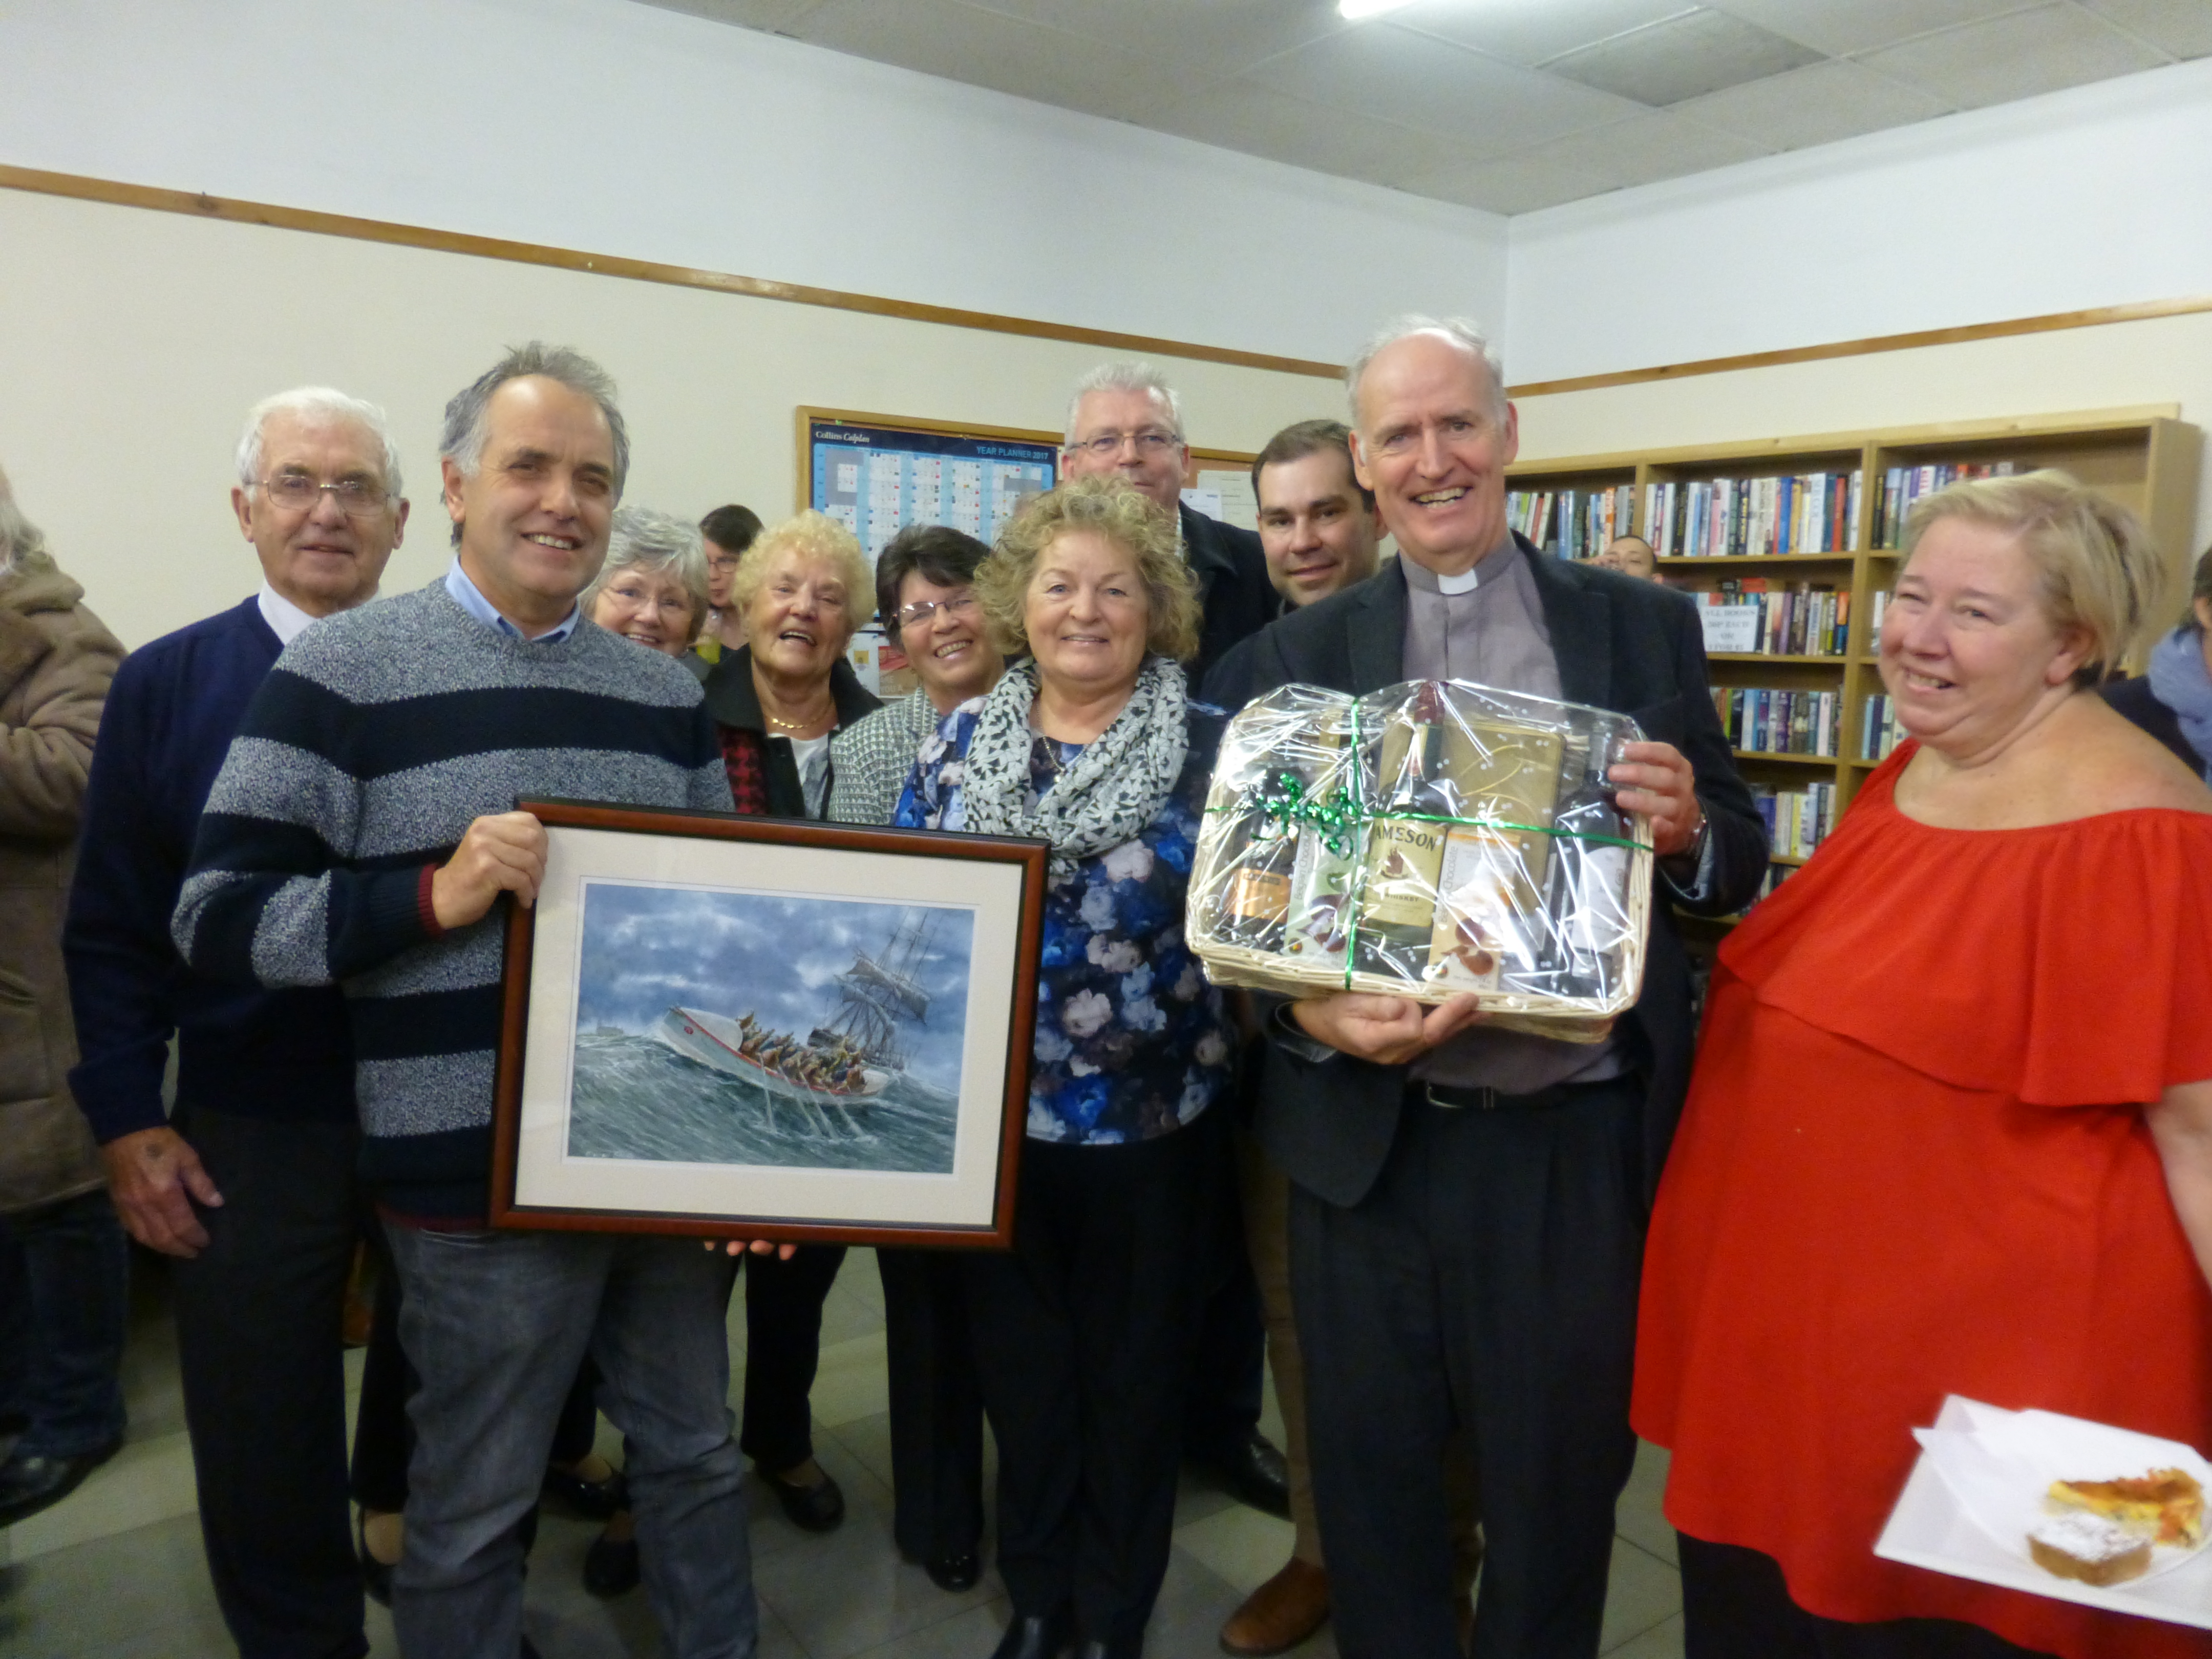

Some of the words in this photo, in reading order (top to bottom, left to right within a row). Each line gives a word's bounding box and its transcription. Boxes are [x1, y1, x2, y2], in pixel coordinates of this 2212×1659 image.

[816, 431, 842, 440] Collins
[843, 433, 870, 444] Calplan
[976, 446, 996, 455] YEAR
[998, 448, 1031, 458] PLANNER
[1373, 825, 1437, 852] AMESON
[1442, 846, 1458, 889] Chocolate
[1294, 869, 1307, 900] Belgian
